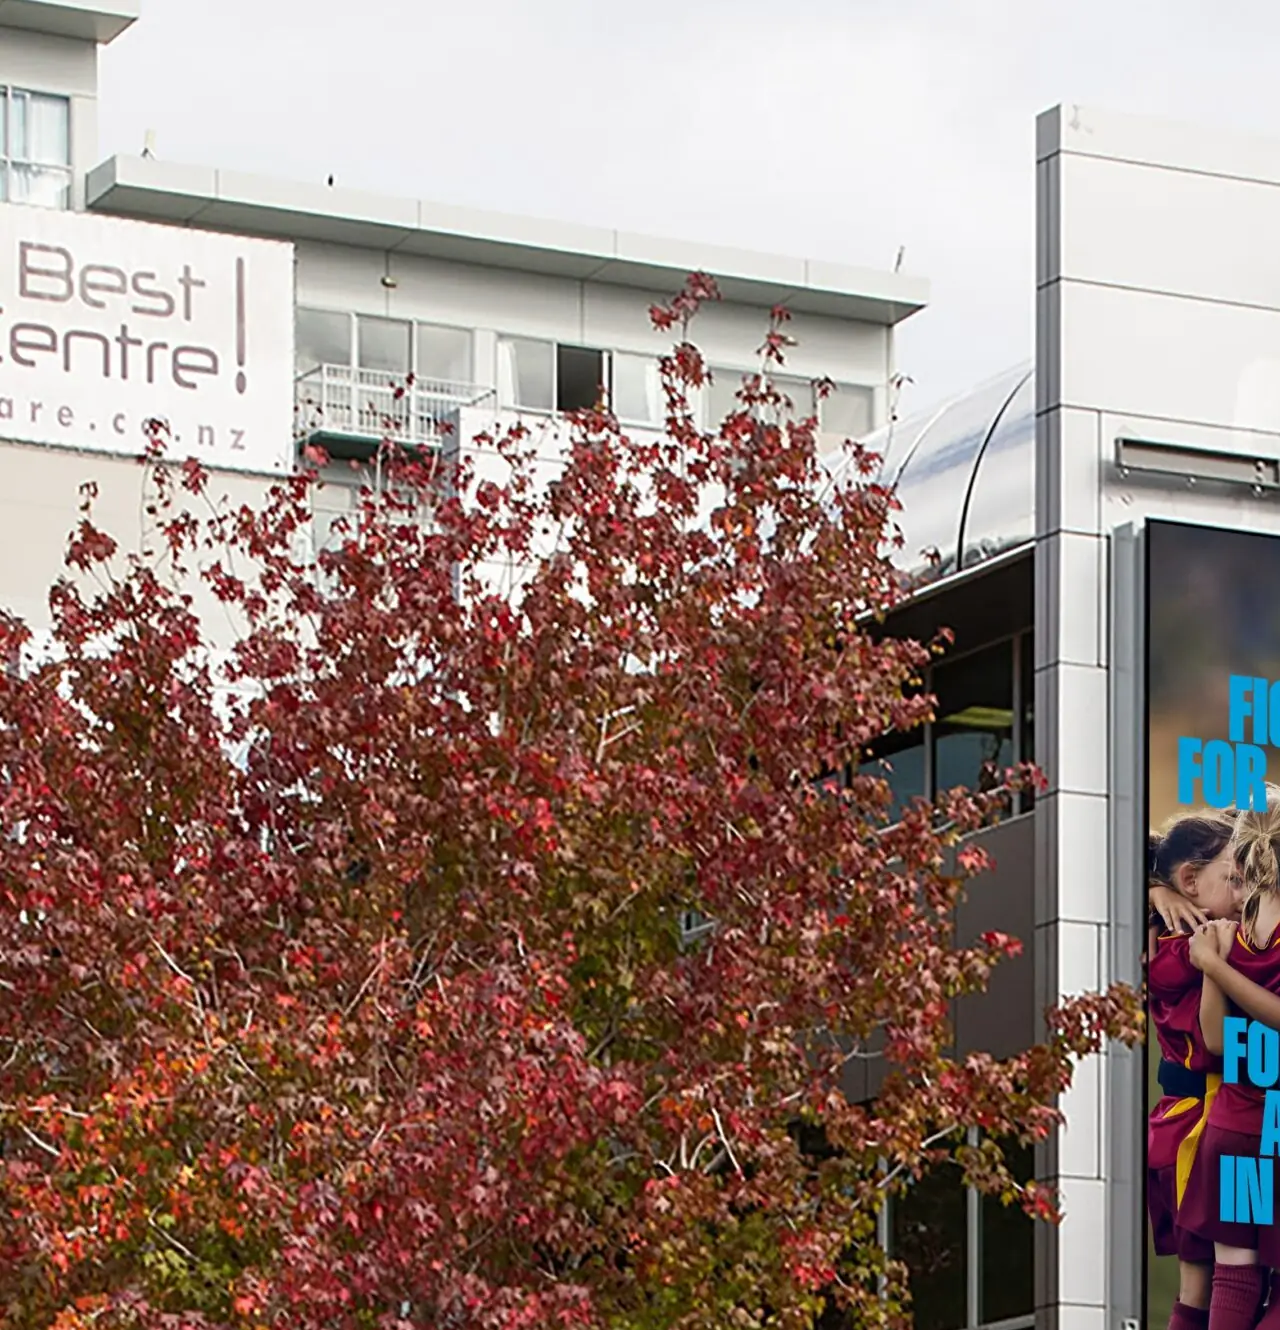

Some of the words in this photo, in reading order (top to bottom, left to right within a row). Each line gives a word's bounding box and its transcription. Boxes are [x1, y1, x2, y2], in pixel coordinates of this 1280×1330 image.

[19, 240, 206, 322] Best
[0, 322, 219, 390] entre
[1178, 736, 1269, 813] FOR
[1219, 1154, 1274, 1225] IN
